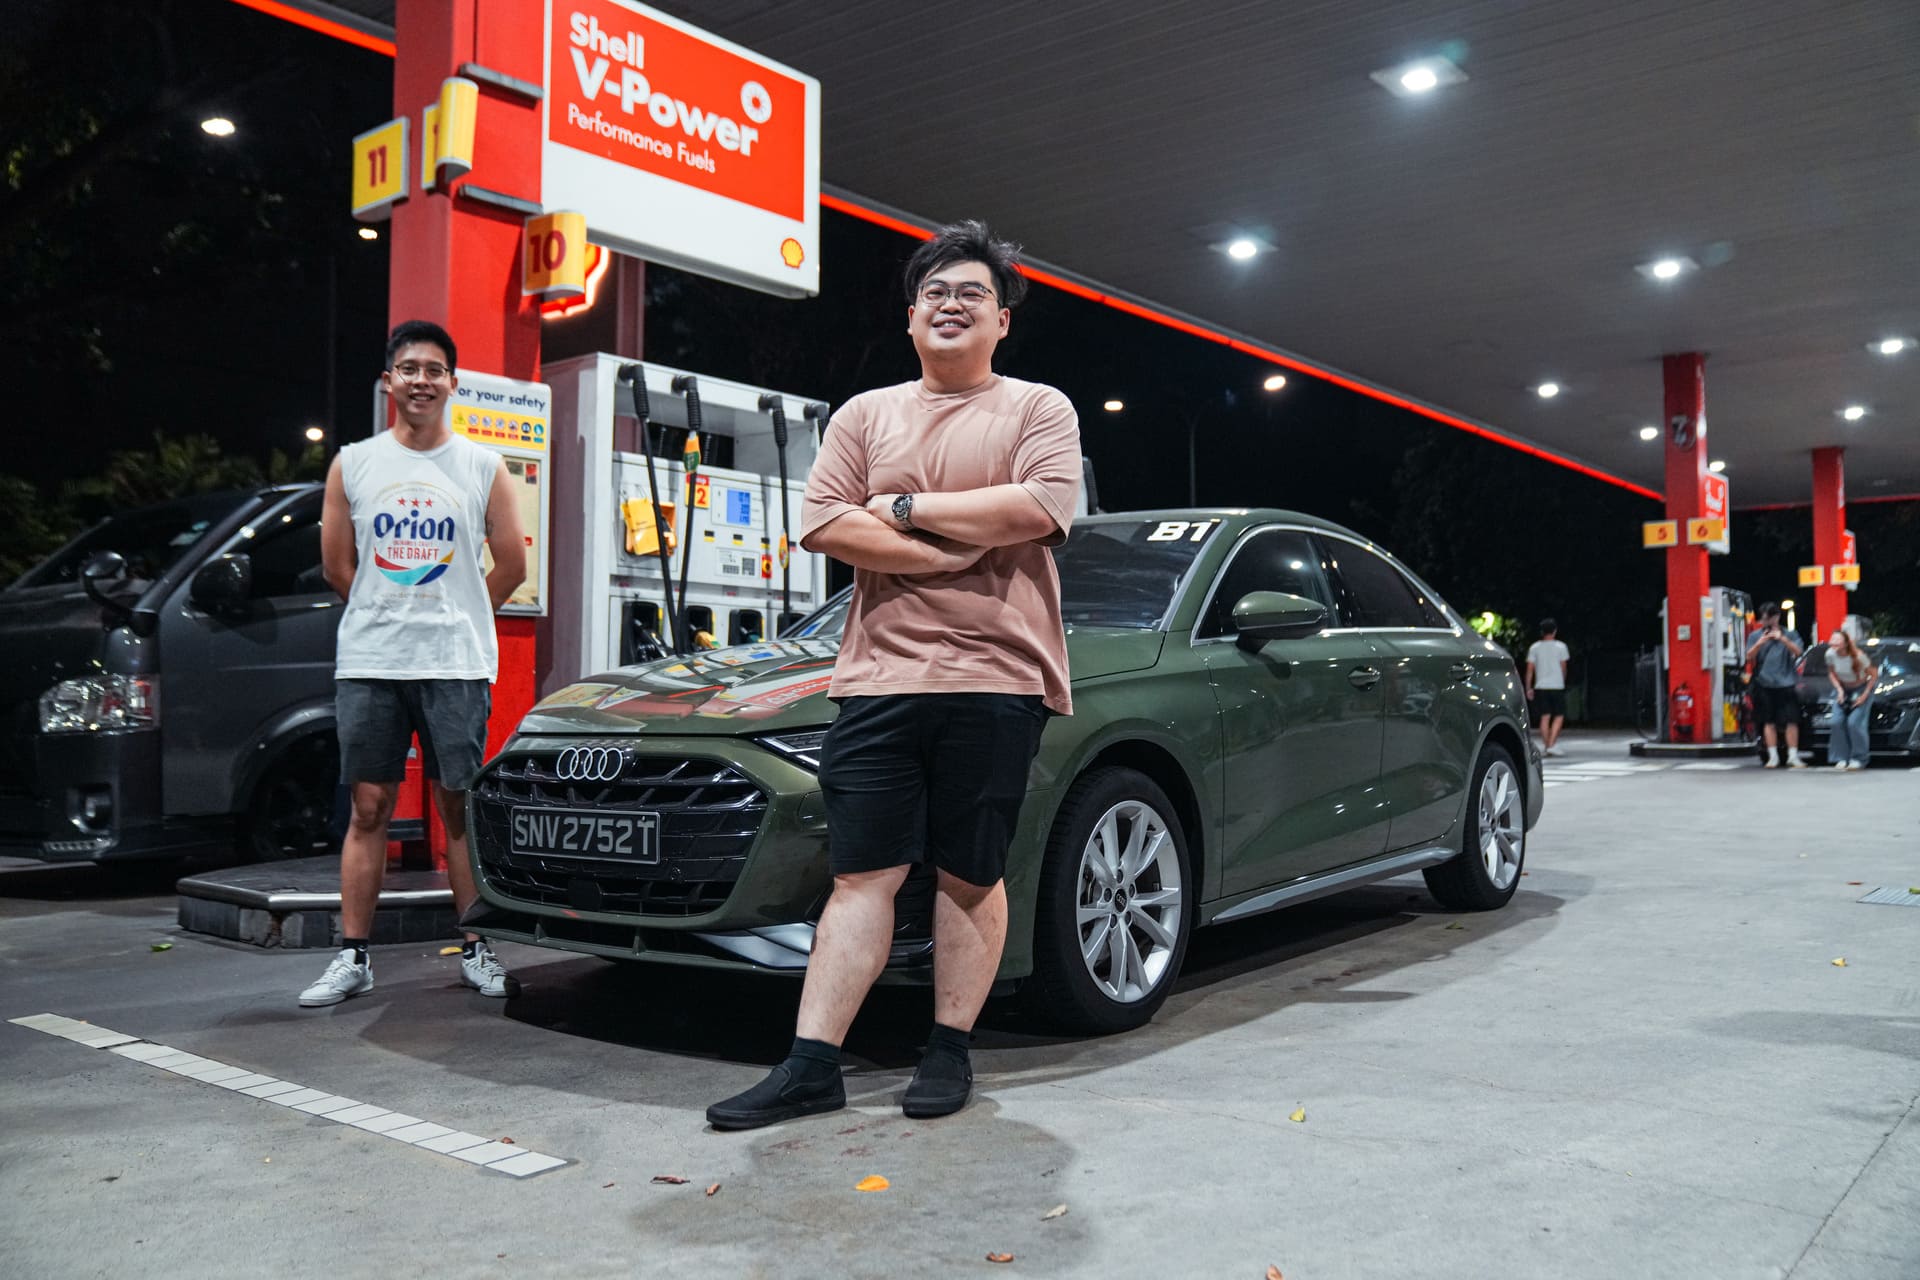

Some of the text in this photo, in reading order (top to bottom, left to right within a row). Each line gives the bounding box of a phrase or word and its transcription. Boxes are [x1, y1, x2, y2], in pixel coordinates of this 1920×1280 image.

[570, 11, 645, 70] Shell
[570, 46, 759, 157] V-Power
[568, 102, 716, 174] Performance Fuels
[368, 145, 387, 188] 11
[529, 230, 567, 274] 10
[458, 387, 546, 413] or your safety
[374, 509, 455, 541] Orion
[1147, 521, 1213, 542] B1
[387, 546, 440, 561] THE DRAFT
[514, 813, 655, 856] SNV2752T
